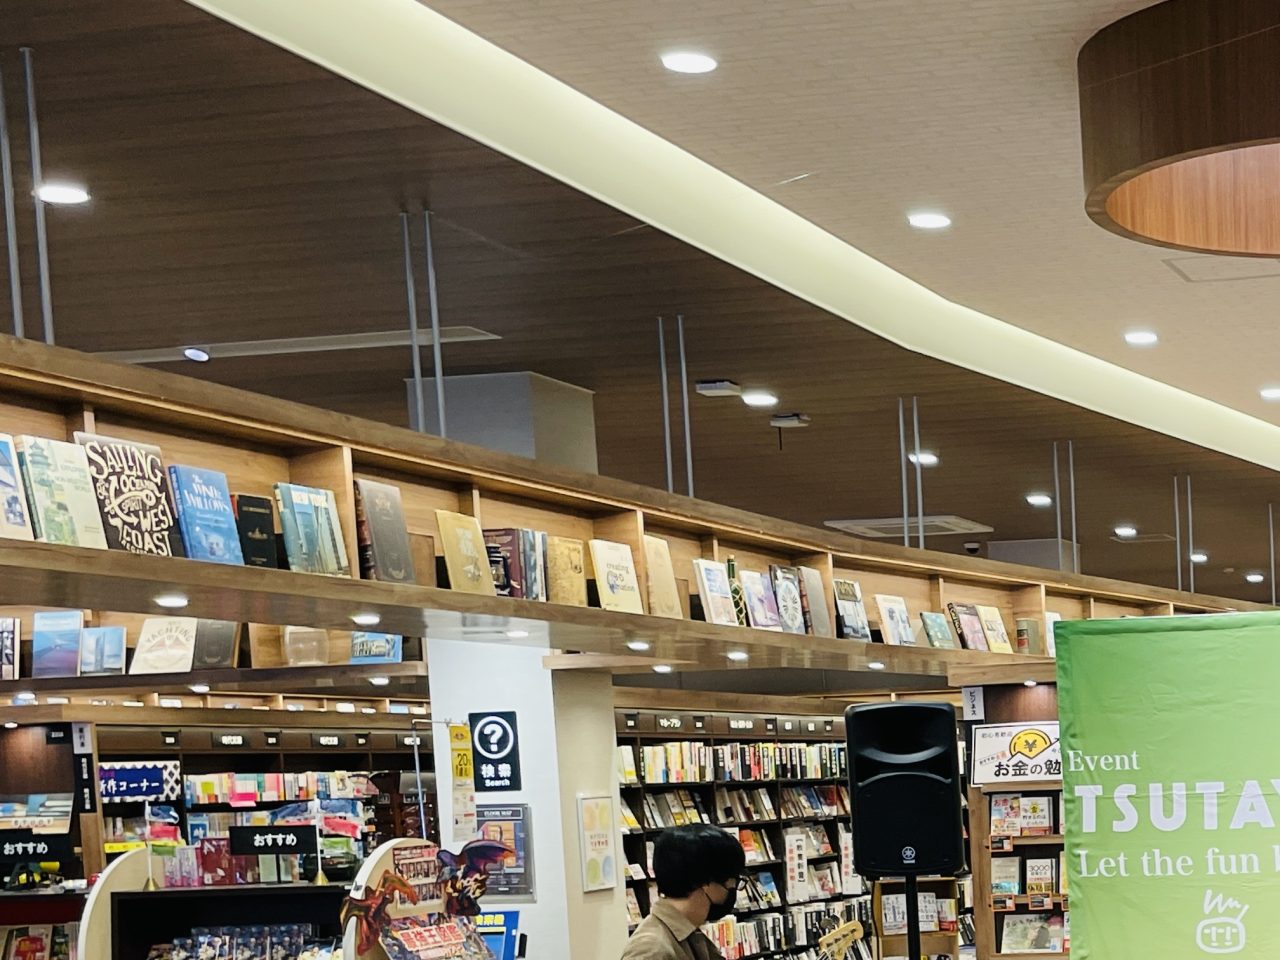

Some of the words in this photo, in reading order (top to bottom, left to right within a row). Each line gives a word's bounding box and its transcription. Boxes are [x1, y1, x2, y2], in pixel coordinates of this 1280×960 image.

[85, 441, 163, 486] SAILING
[122, 526, 173, 556] COAST
[969, 691, 977, 716] ビジネス
[481, 763, 511, 778] 検索
[994, 759, 1062, 777] お金の勉
[1068, 749, 1141, 772] Event
[485, 779, 510, 787] Search
[3, 842, 48, 855] おすすめ
[254, 833, 297, 847] おすすめ
[1077, 849, 1129, 878] Let
[1141, 848, 1193, 877] the
[1205, 847, 1260, 875] fun
